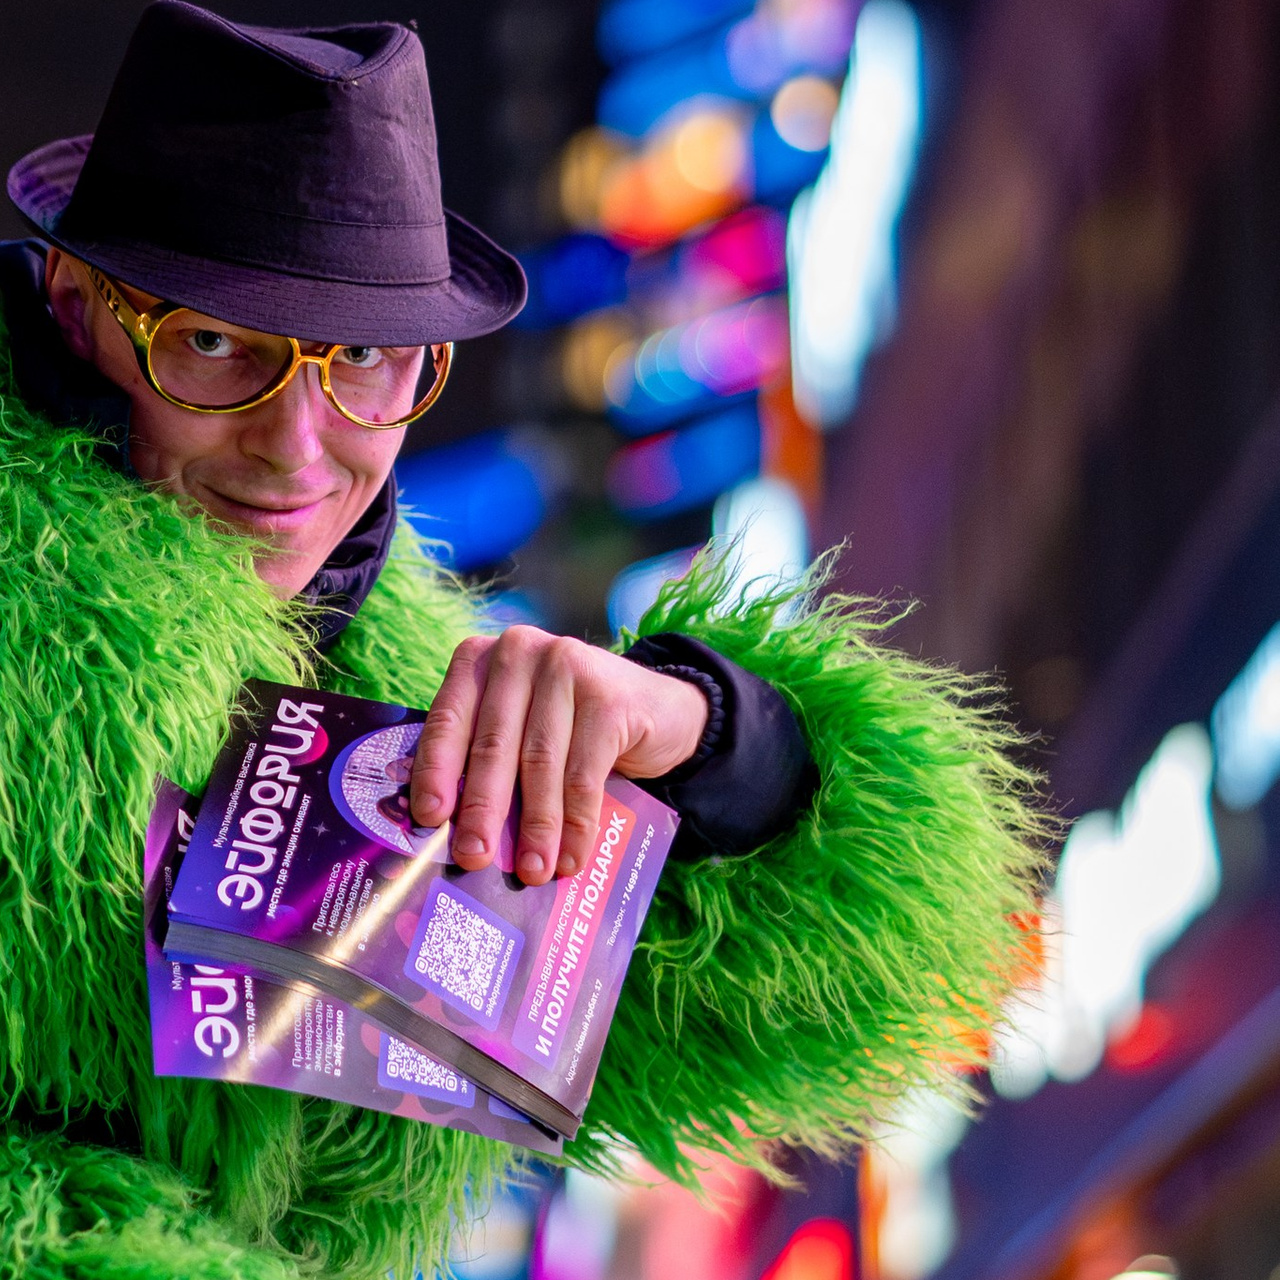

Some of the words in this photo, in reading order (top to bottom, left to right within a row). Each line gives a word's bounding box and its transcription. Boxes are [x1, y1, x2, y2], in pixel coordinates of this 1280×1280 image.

[213, 778, 245, 848] Мультимедийная
[239, 742, 257, 778] выставка
[292, 793, 312, 833] оживают
[276, 868, 288, 885] где
[281, 834, 299, 868] эмоции
[578, 811, 628, 919] ПОДАРОК
[606, 908, 627, 947] Телефон:
[634, 823, 656, 871] 325-75-57
[266, 884, 285, 919] место,
[312, 862, 342, 932] Приготовьтесь
[328, 859, 356, 929] невероятному
[485, 939, 516, 1018] эйфория.москва
[527, 942, 560, 1023] ПРЕДЪЯВИТЕ
[552, 873, 579, 946] ЛИСТОВКУ
[541, 917, 589, 1037] ПОЛУЧИТЕ
[245, 1001, 256, 1021] где
[324, 1004, 334, 1075] путешестви
[333, 1009, 346, 1067] эйфорию
[534, 1034, 553, 1057] И
[574, 1021, 590, 1054] Новый
